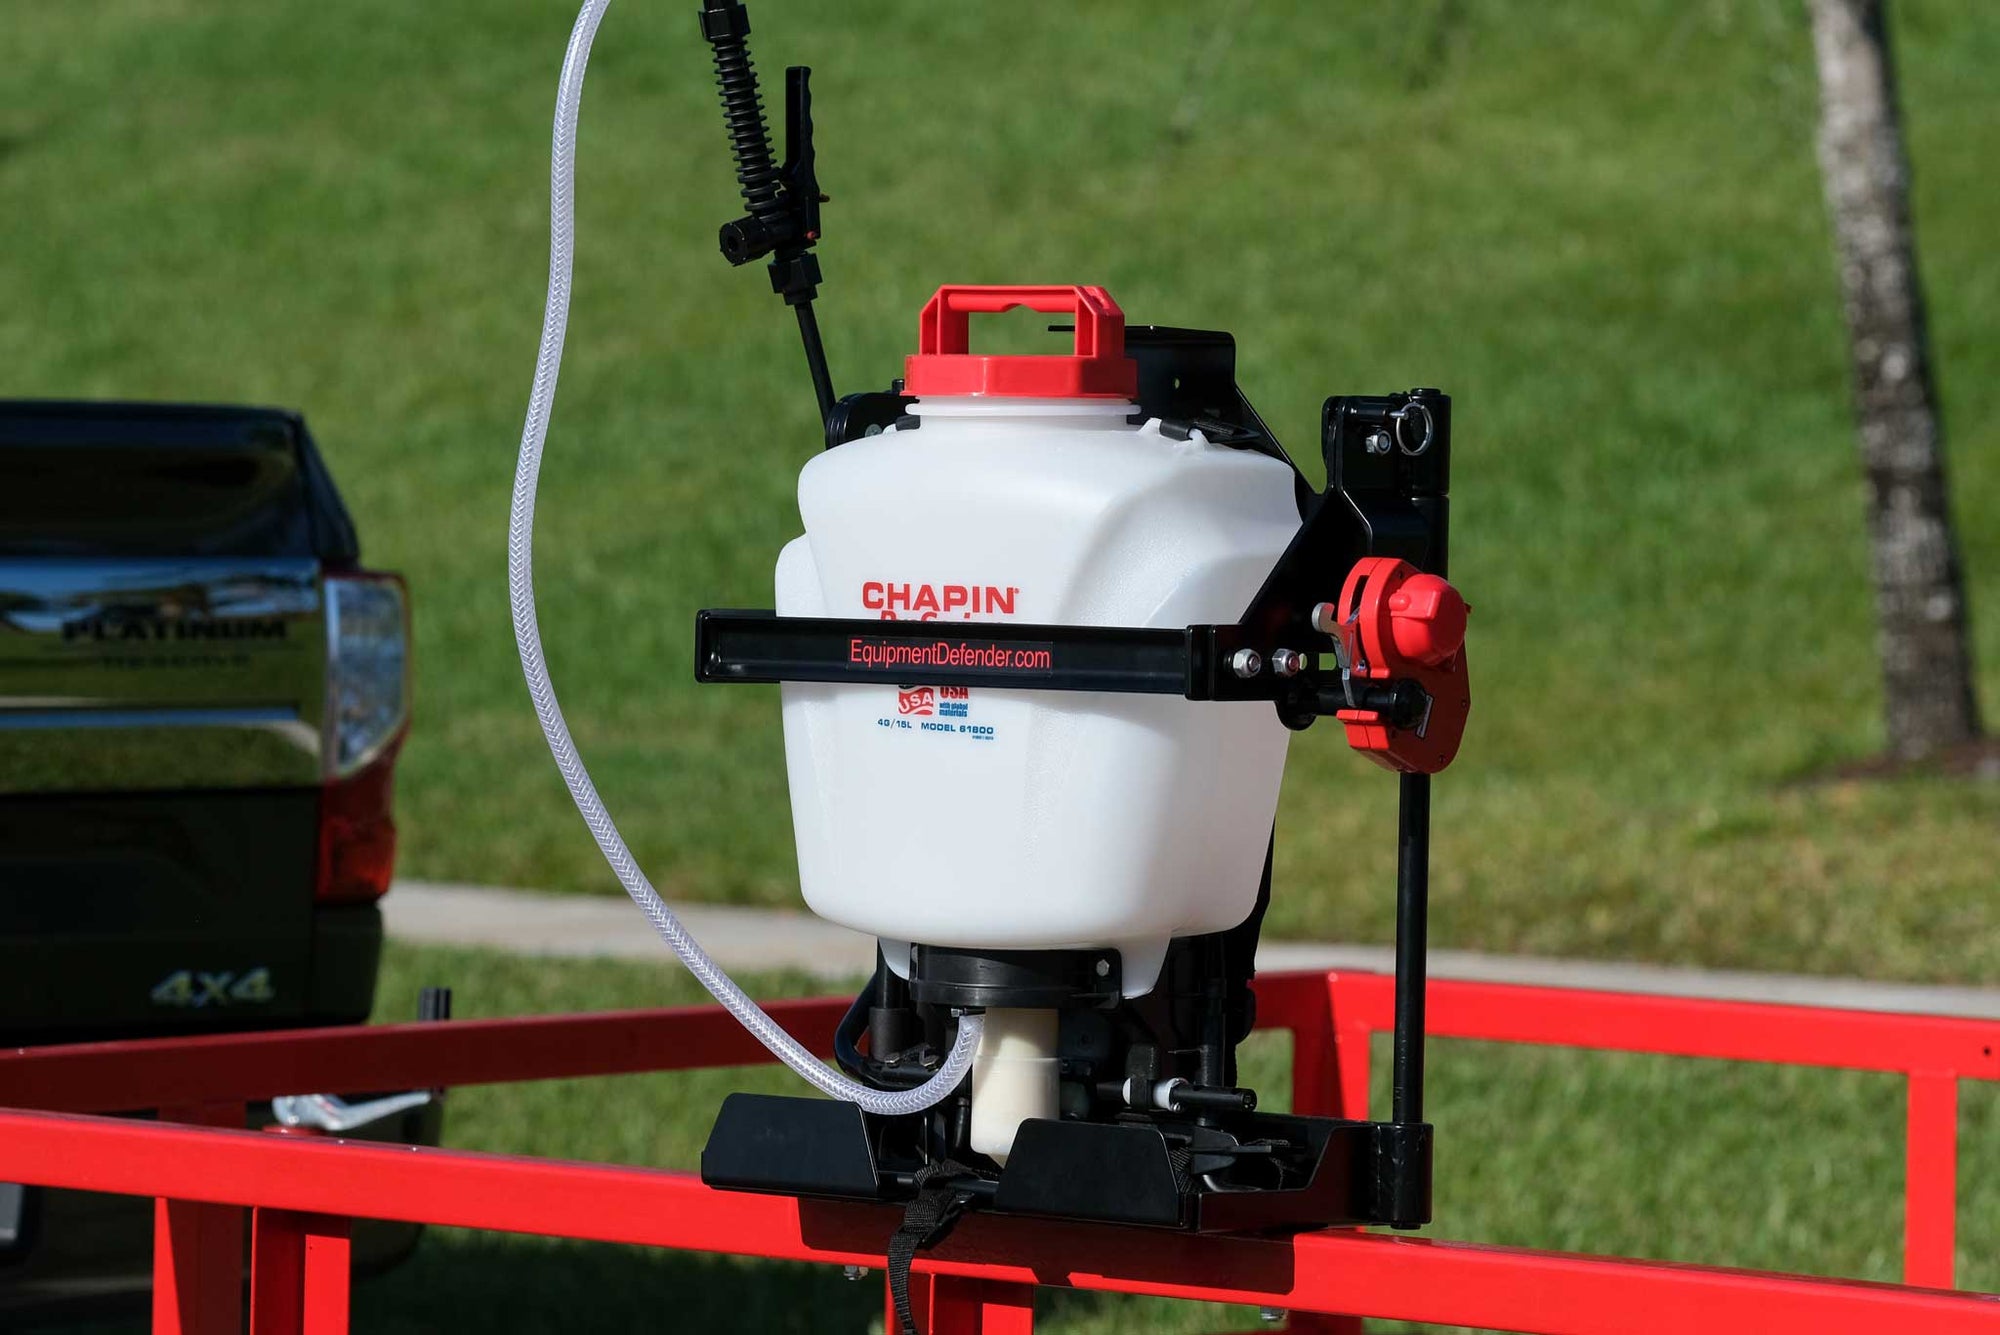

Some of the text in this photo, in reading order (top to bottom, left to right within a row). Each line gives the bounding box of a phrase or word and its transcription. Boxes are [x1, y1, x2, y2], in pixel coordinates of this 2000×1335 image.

[63, 620, 286, 641] PLATINUM
[850, 638, 1051, 669] EquipmentDefender.com
[898, 691, 934, 714] USA
[939, 686, 969, 700] USA
[939, 709, 968, 718] materials
[877, 718, 994, 735] 4G/15L MODEL 61800
